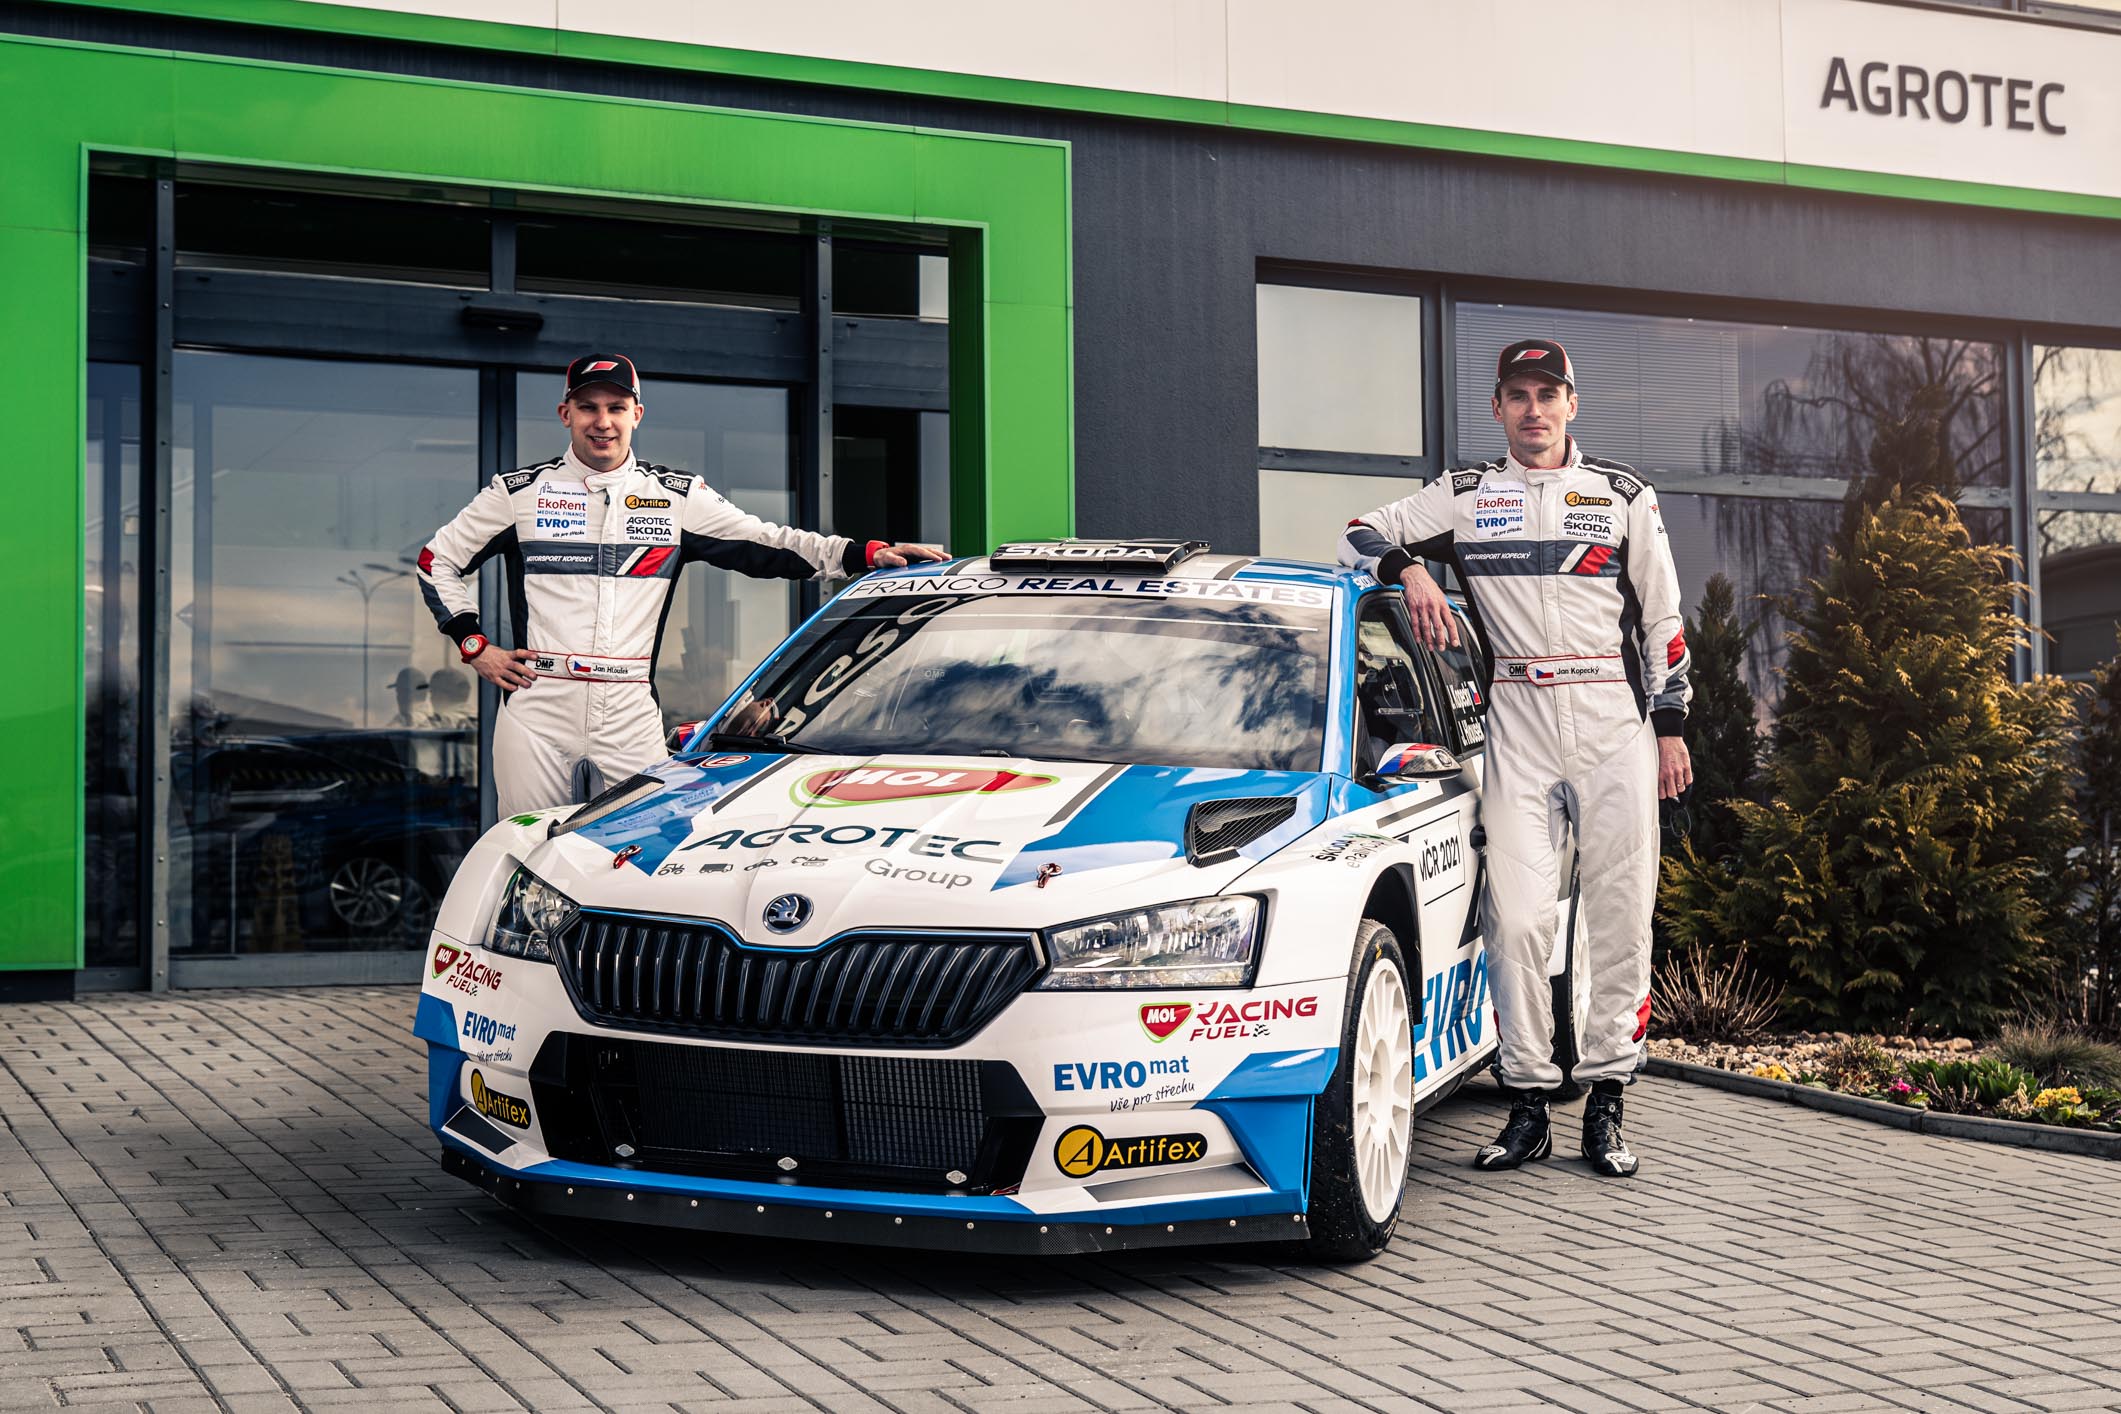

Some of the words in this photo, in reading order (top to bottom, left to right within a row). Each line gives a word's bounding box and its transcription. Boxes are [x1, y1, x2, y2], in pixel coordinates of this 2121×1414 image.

[1820, 56, 2067, 135] AGROTEC
[507, 476, 530, 487] OMP
[665, 478, 688, 490] OMP
[1454, 476, 1478, 487] OMP
[1615, 476, 1638, 495] OMP
[537, 498, 586, 511] EkoRent
[640, 499, 669, 507] Artifex
[1477, 497, 1523, 508] EkoRent
[1580, 497, 1611, 506] Artifex
[537, 518, 570, 528] EVRO
[627, 516, 672, 526] AGROTEC
[1476, 517, 1507, 528] EVRO
[1565, 512, 1612, 525] AGROTEC
[626, 525, 672, 536] ŠKODA
[1564, 520, 1611, 534] ŠKODA
[526, 555, 562, 563] MOTORSPORT
[562, 554, 594, 562] KOPECKÝ
[1465, 552, 1501, 560] MOTORSPORT
[1501, 551, 1531, 560] KOPECKÝ
[848, 577, 1008, 597] FRANCO
[1016, 577, 1124, 591] REAL
[1136, 579, 1323, 605] ESTATES
[535, 659, 555, 668] OMP
[592, 665, 606, 673] Jan
[1556, 667, 1569, 675] Jan
[1570, 667, 1600, 676] Kopecký
[820, 769, 968, 788] MOL
[679, 824, 1004, 864] AGROTEC
[1440, 835, 1461, 872] 2021
[865, 858, 972, 890] Group
[436, 948, 452, 963] MOL
[456, 951, 503, 991] RACING
[446, 975, 471, 994] FUEL
[1146, 1007, 1177, 1024] MOL
[1196, 996, 1318, 1026] RACING
[462, 1010, 496, 1046] EVRO
[497, 1022, 517, 1042] mat
[1190, 1025, 1251, 1042] FUEL
[1054, 1060, 1147, 1092] EVRO
[1150, 1055, 1190, 1074] mat
[1132, 1093, 1151, 1111] pro
[1155, 1078, 1196, 1101] střechu
[487, 1091, 529, 1126] Artifex
[1103, 1137, 1202, 1167] Artifex
